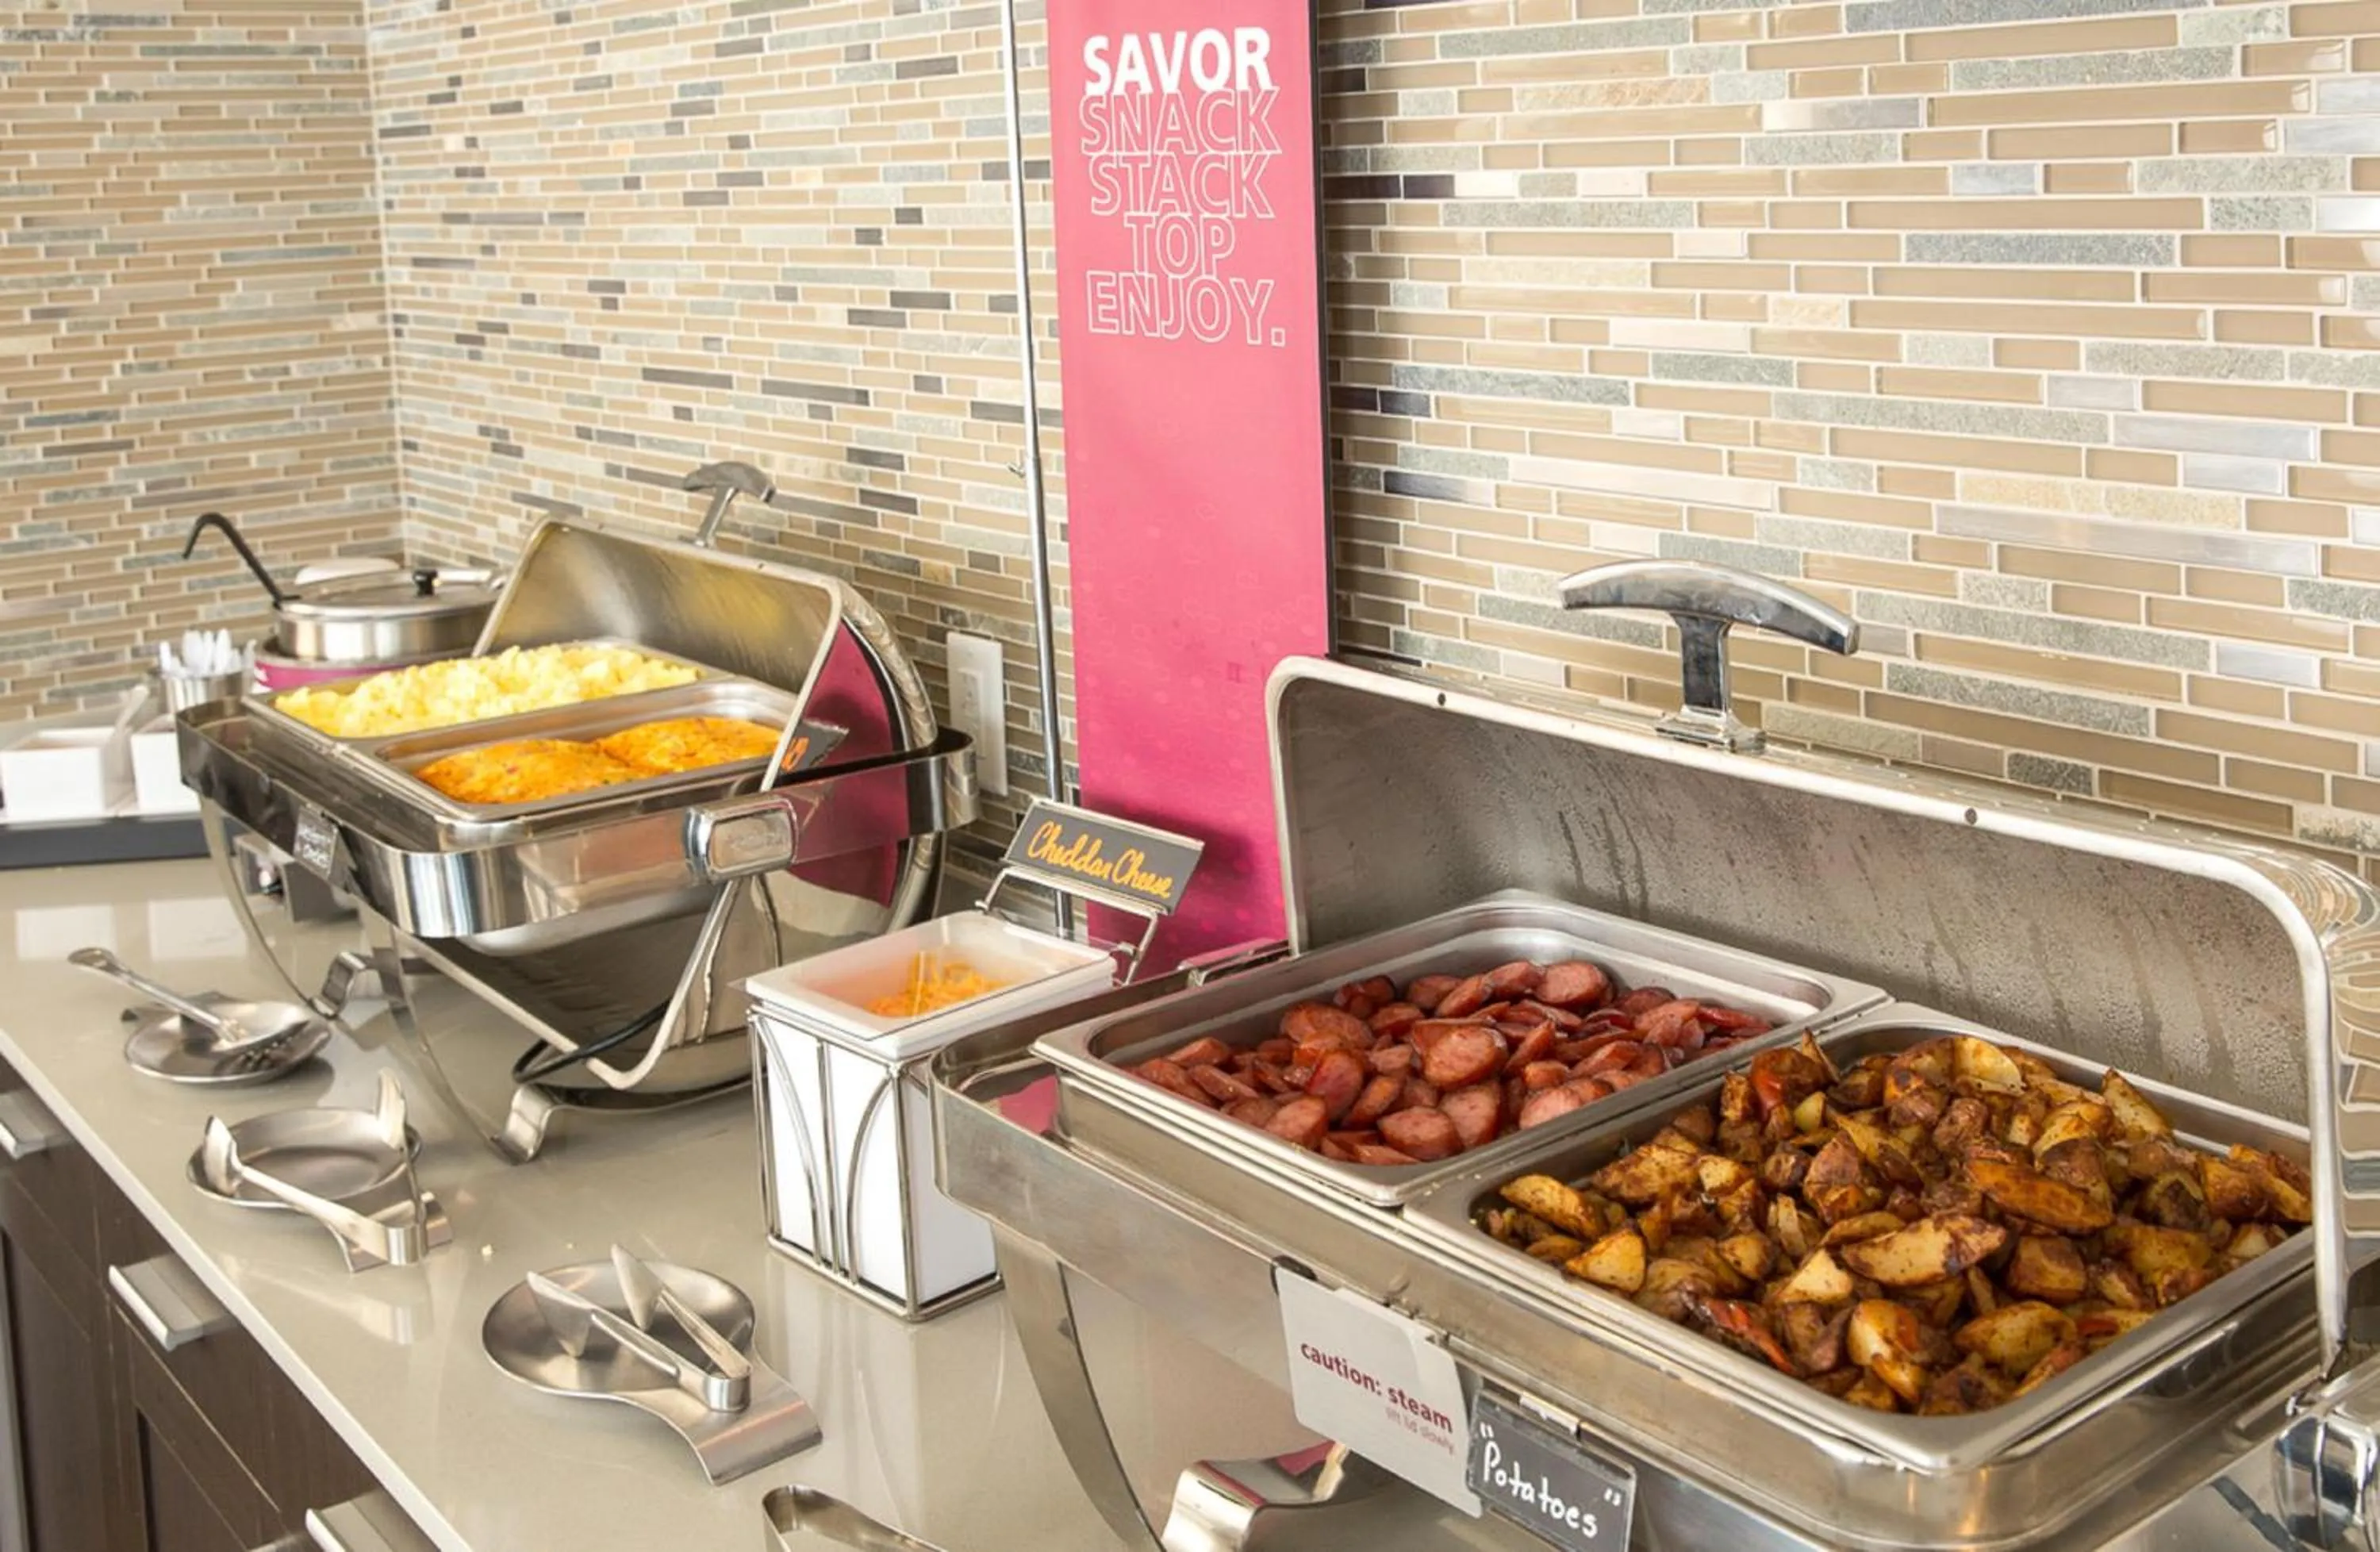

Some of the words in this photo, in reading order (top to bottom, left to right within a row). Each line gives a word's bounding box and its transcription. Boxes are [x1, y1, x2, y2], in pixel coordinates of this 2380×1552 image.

[1083, 26, 1273, 95] SAVOR
[1079, 86, 1283, 156] SNACK
[1088, 151, 1276, 219] STACK
[1123, 212, 1236, 279] TOP
[1085, 270, 1286, 348] ENJOY.
[1027, 820, 1112, 882] Cheddar
[1111, 847, 1173, 899] Cheese
[1300, 1343, 1382, 1396] caution:
[1388, 1387, 1453, 1434] steam
